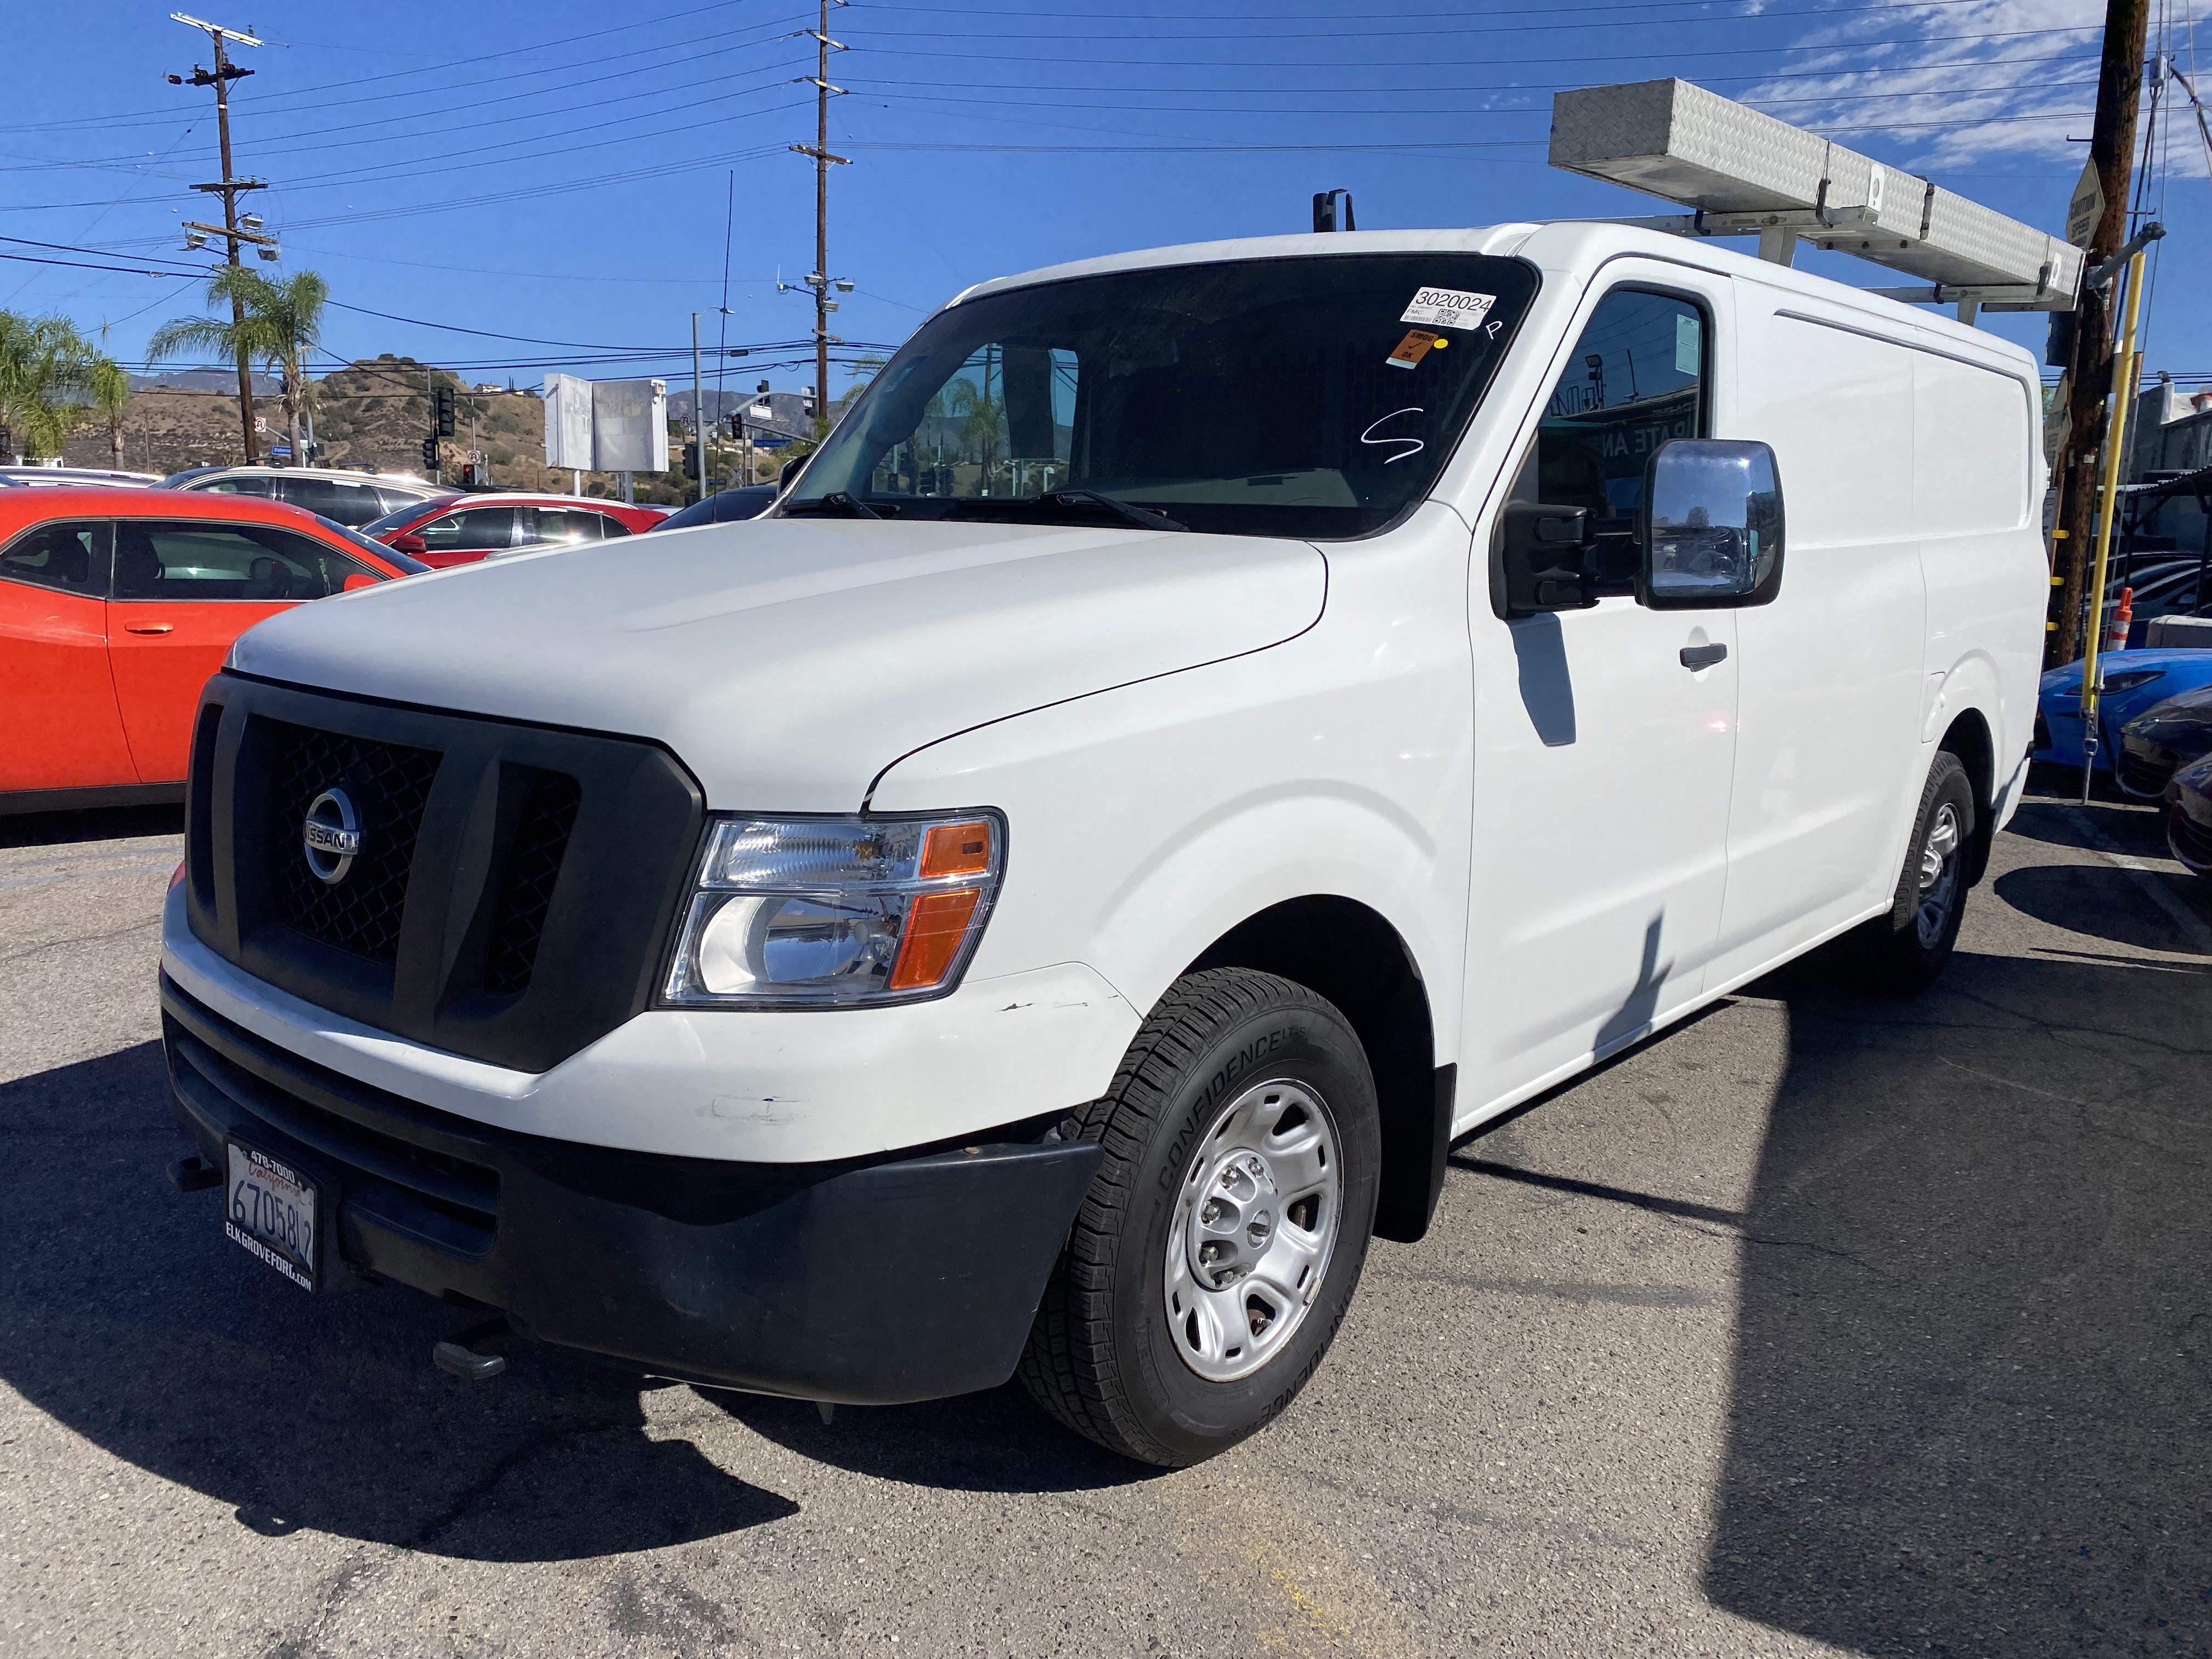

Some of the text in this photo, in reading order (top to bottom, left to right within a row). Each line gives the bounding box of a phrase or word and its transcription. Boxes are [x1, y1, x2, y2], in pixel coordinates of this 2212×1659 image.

[2069, 190, 2097, 221] CAUTION
[2071, 216, 2090, 239] SPEED
[1415, 291, 1492, 313] 3020024
[1410, 331, 1435, 342] SMOG
[1485, 321, 1503, 340] P
[304, 823, 346, 849] NISSAN
[1156, 1030, 1280, 1193] CONFIDENCE
[251, 1150, 296, 1184] 478-7000
